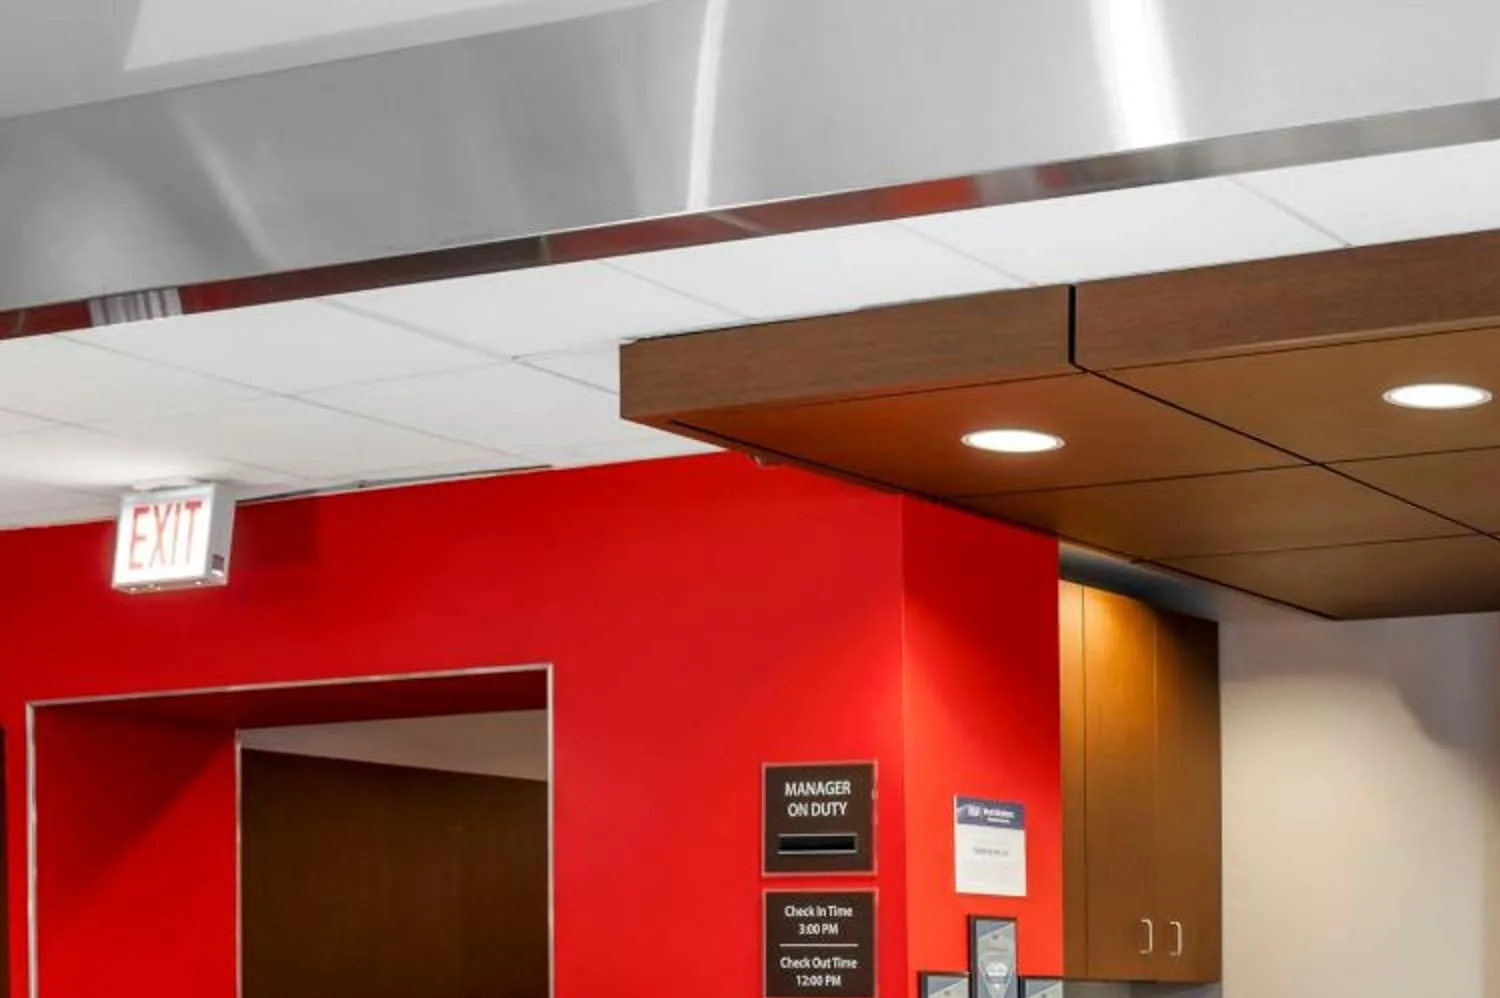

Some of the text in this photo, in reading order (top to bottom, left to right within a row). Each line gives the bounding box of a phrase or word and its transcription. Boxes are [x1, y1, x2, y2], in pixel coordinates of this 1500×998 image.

[128, 500, 203, 570] EXIT
[784, 781, 851, 797] MANAGER
[787, 801, 848, 817] ON DUTY
[784, 905, 853, 917] Check In Time
[798, 923, 839, 935] 3:00 PM
[780, 956, 858, 969] Check Out Time
[796, 975, 842, 987] 12:00 PM
